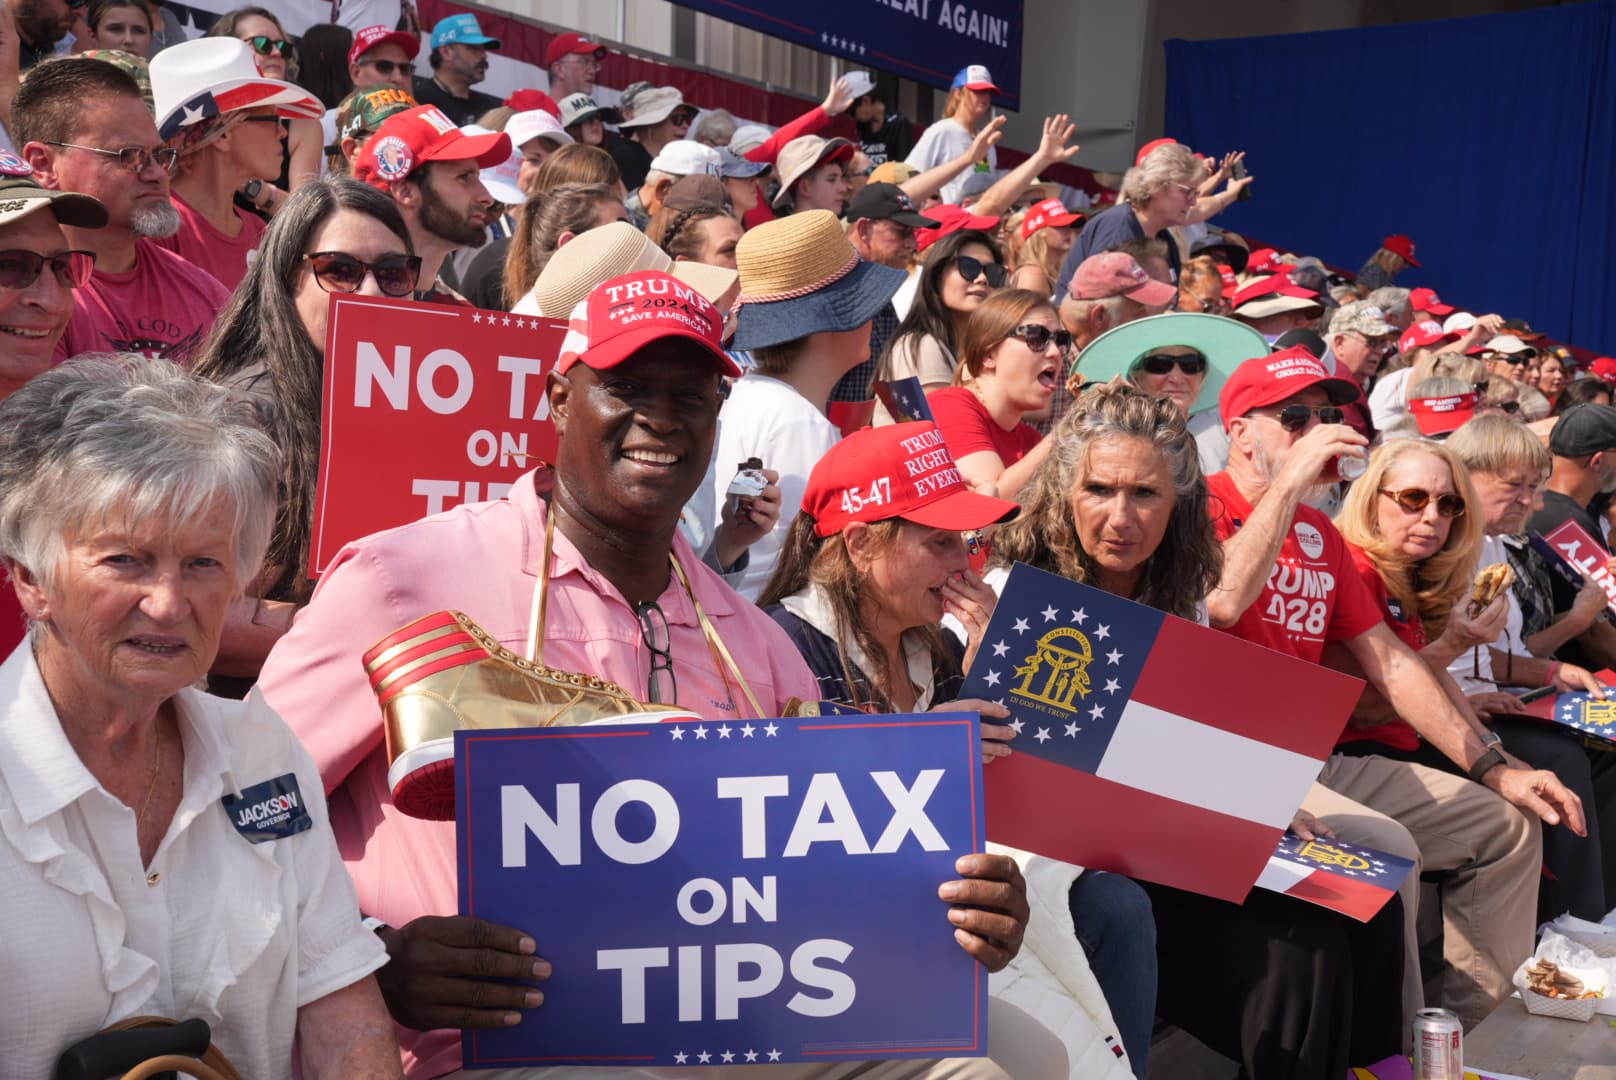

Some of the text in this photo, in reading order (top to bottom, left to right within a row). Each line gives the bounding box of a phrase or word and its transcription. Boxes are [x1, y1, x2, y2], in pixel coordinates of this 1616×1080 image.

[938, 0, 1008, 47] AGAIN!
[366, 88, 417, 109] TRU
[606, 278, 711, 313] TRUMP
[641, 298, 691, 315] 2024
[621, 311, 655, 325] SAVE
[353, 341, 474, 414] NO
[466, 429, 528, 468] ON
[900, 429, 945, 455] TRUM
[840, 476, 891, 514] 45-47
[1019, 698, 1035, 709] GOD
[1035, 702, 1047, 713] WE
[1047, 706, 1070, 720] TRUST
[238, 791, 298, 827] JACKSON
[256, 812, 291, 830] GOVERNOR
[501, 768, 950, 868] NO TAX
[676, 875, 777, 926] ON
[596, 938, 856, 1024] TIPS
